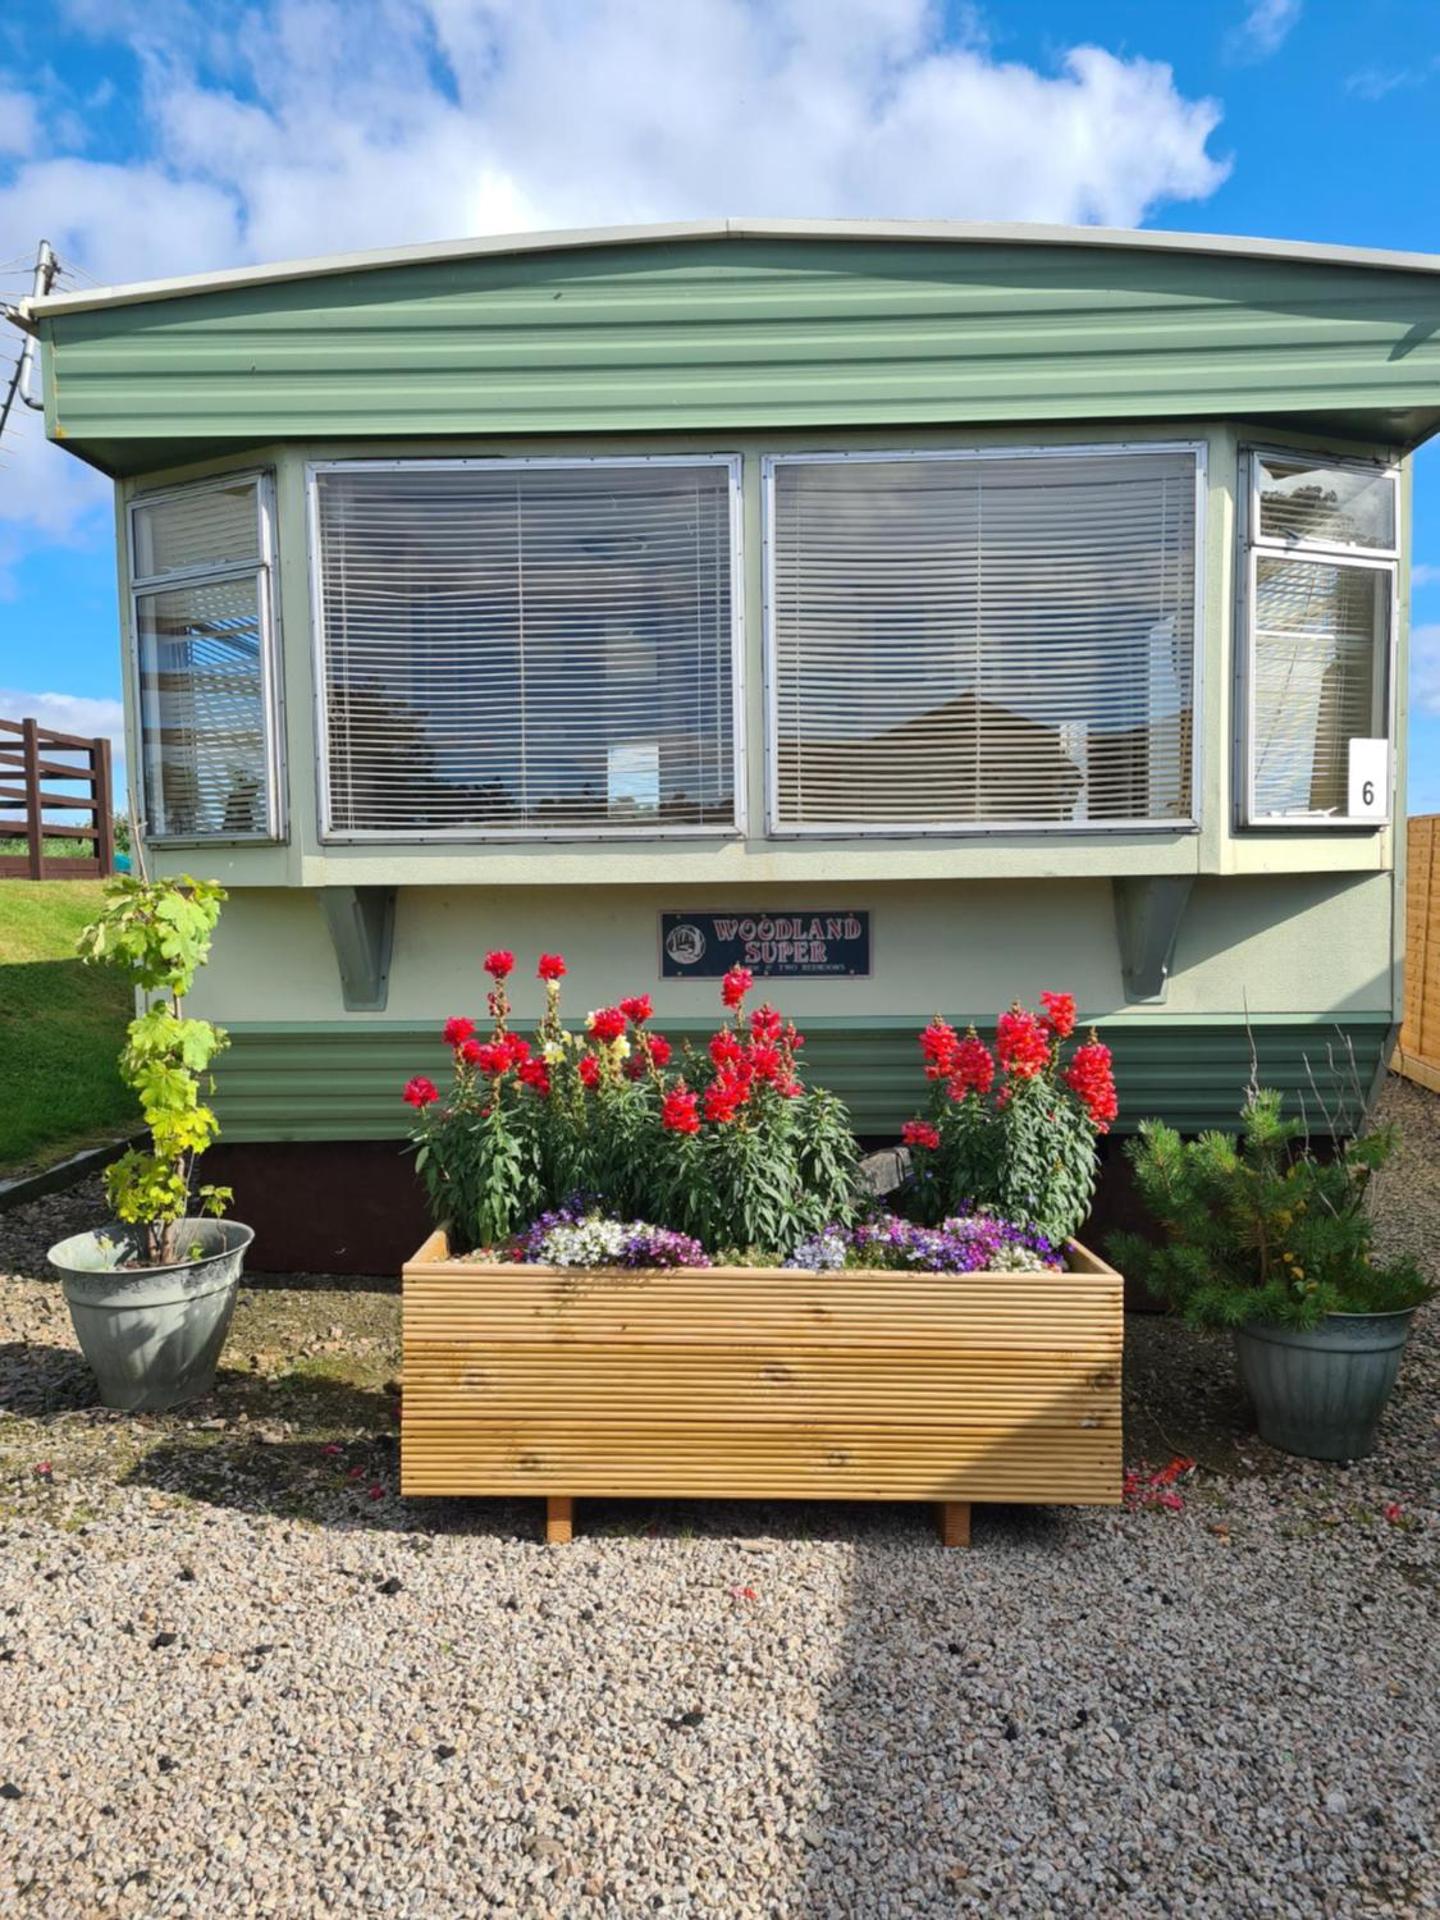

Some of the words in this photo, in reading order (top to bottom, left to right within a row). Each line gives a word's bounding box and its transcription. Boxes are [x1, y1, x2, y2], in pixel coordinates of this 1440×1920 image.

[1362, 780, 1374, 806] 6
[713, 918, 862, 941] WOODLAND
[744, 940, 828, 963] SUPER
